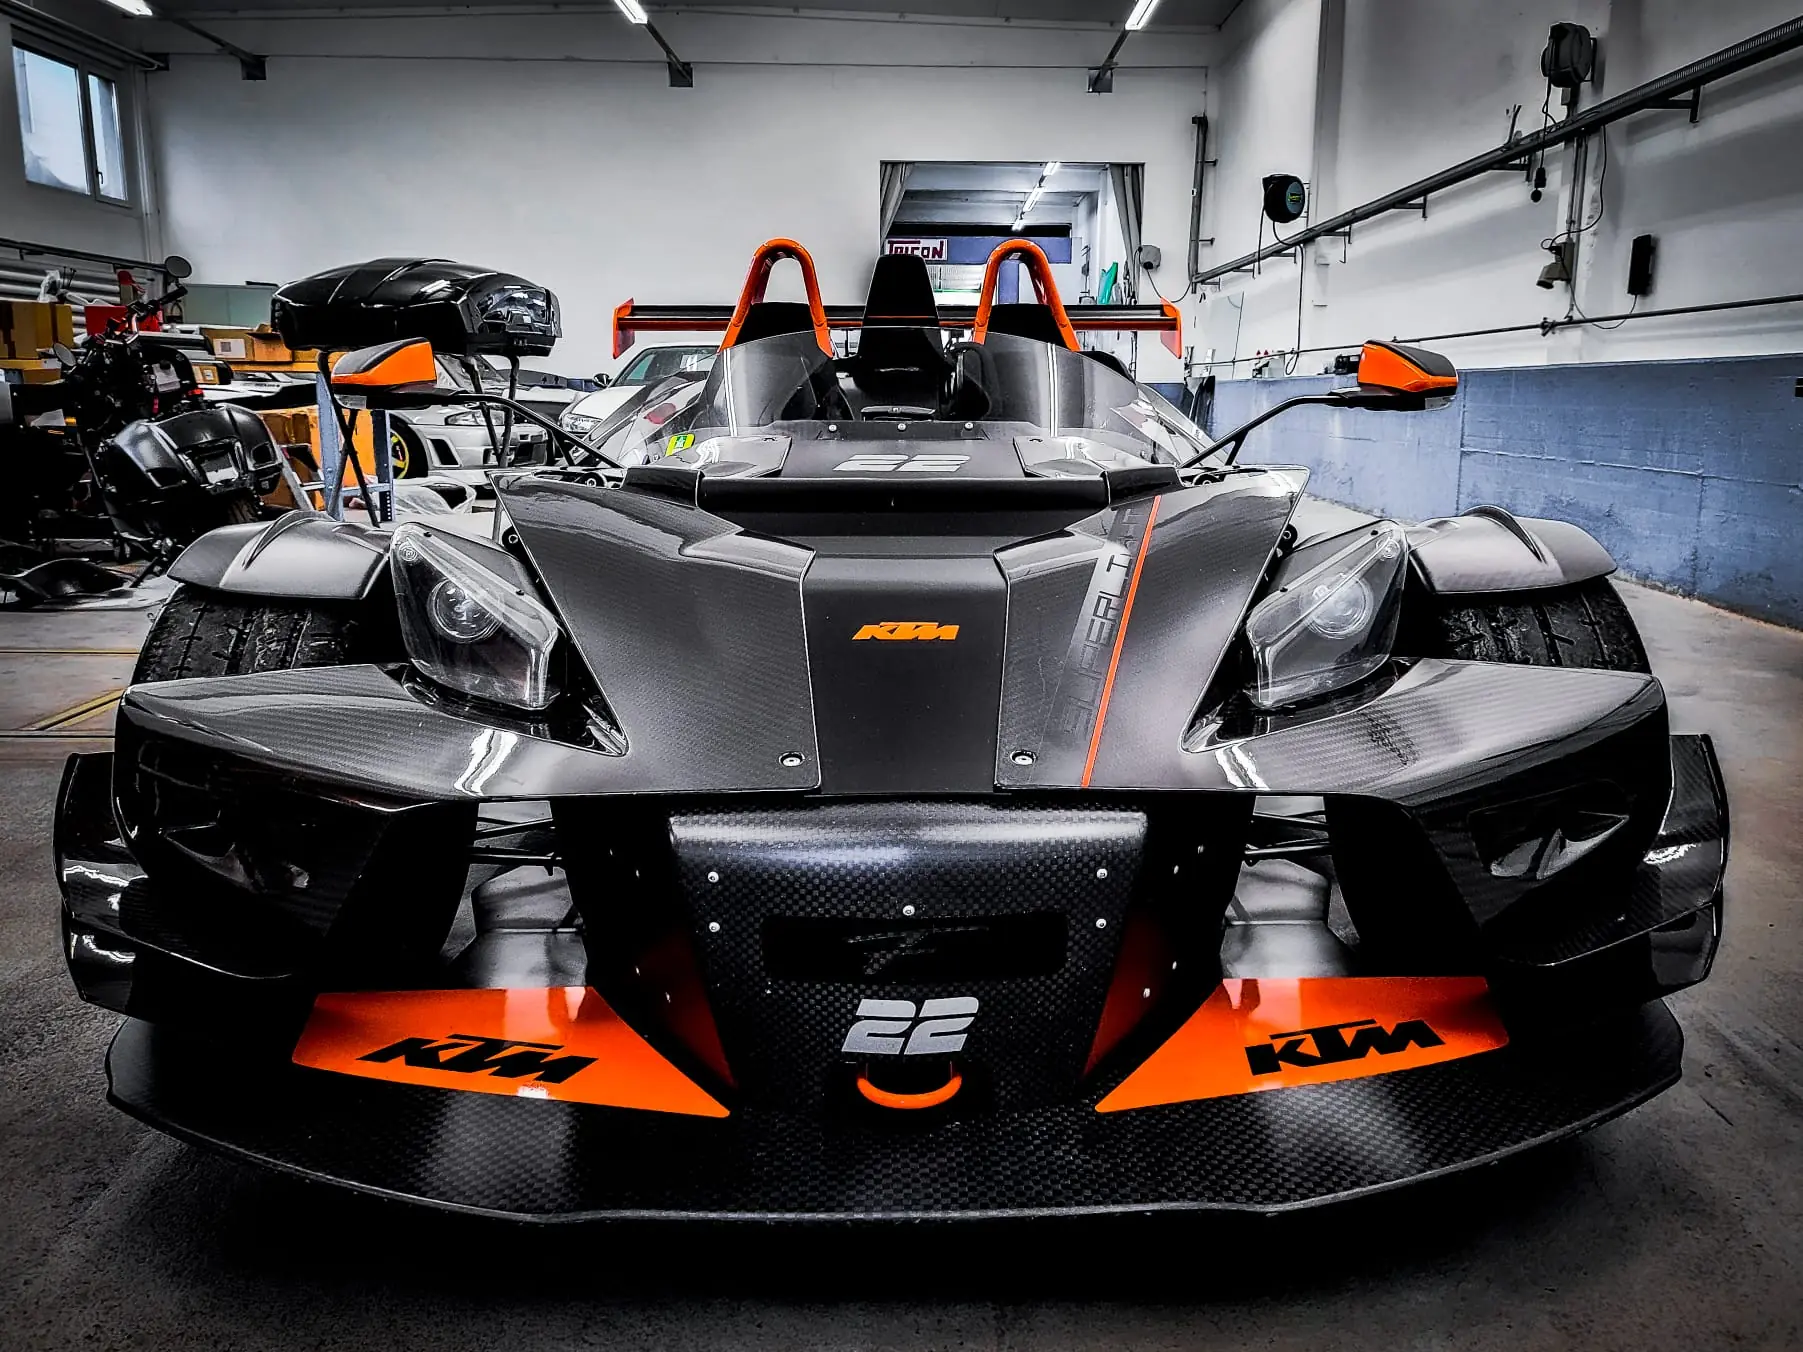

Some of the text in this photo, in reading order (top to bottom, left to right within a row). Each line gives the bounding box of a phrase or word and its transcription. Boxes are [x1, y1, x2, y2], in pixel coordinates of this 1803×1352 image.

[832, 454, 971, 472] 22
[851, 621, 960, 641] KTM
[841, 996, 979, 1055] 22
[1244, 1018, 1446, 1076] KTM
[355, 1033, 599, 1084] KTM
